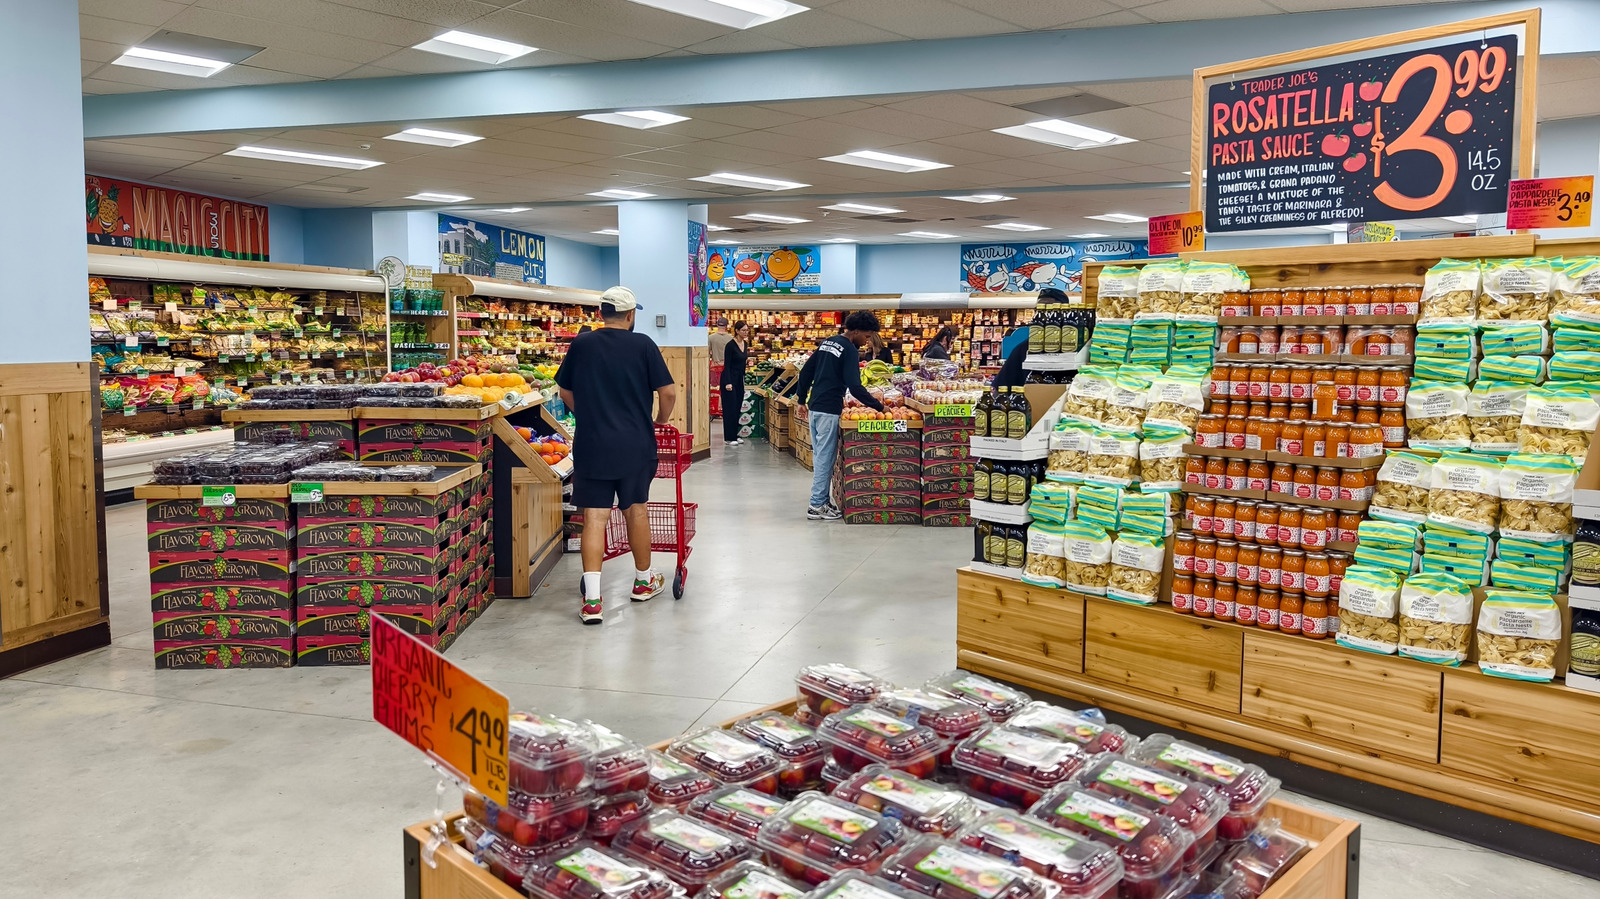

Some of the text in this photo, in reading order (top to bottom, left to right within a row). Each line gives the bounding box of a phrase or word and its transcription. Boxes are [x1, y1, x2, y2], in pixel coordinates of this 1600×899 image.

[1242, 71, 1318, 95] TRADER JOE'S
[1213, 82, 1354, 138] ROSATELLA
[1212, 132, 1314, 166] PASTA SAUCE
[1468, 148, 1501, 171] 14.5
[1217, 162, 1334, 181] MADE WITH CREAM, ITALIAN
[1269, 178, 1298, 189] GRANA
[1301, 174, 1336, 186] PADANO
[1471, 174, 1498, 191] OZ
[1511, 183, 1543, 191] ORGANIC
[1218, 186, 1345, 206] CHEESE! A MIXTURE OF THE
[1511, 189, 1563, 200] PAPPARDELLE
[1218, 197, 1343, 216] TANGY TASTE OF MARINARA &
[1510, 198, 1556, 208] PASTA NESTS
[132, 187, 266, 261] MAGIC CITY
[1218, 207, 1364, 226] THE SILKY CREAMINESS OF ALFREDO!
[210, 213, 219, 249] 305
[1149, 219, 1181, 232] OLIVE OIL
[500, 229, 544, 262] LEMON
[523, 261, 544, 279] CITY
[937, 407, 966, 416] PEACHES
[311, 426, 343, 437] GROWN
[385, 427, 453, 439] FLAVOR GROWN
[932, 433, 951, 442] FLAVOR
[383, 453, 450, 462] FLAVOR GROWN
[852, 448, 914, 456] FLAVOR GROWN
[931, 466, 951, 474] FLAVOR
[852, 481, 914, 490] FLAVOR GROWN
[928, 483, 948, 491] FLAVOR
[309, 500, 422, 515] FLAVOR GROWN
[852, 497, 914, 506] FLAVOR GROWN
[158, 504, 274, 519] FLAVOR GROWN
[853, 514, 915, 522] FLAVOR GROWN
[930, 517, 949, 525] FLAVOR
[159, 533, 275, 549] FLAVOR GROWN
[309, 529, 422, 544] FLAVOR GROWN
[180, 564, 260, 578] FLAVOR GROWN
[309, 559, 422, 573] FLAVOR GROWN
[163, 594, 277, 609] FLAVOR GROWN
[309, 588, 421, 602] FLAVOR GROWN
[164, 622, 279, 637] FLAVOR GROWN
[324, 618, 356, 632] FLAVOR
[166, 651, 279, 667] FLAVOR GROWN
[327, 649, 359, 662] FLAVOR
[374, 620, 452, 699] ORGANIC
[373, 657, 437, 723] CHERRY
[375, 693, 434, 752] PLUMS
